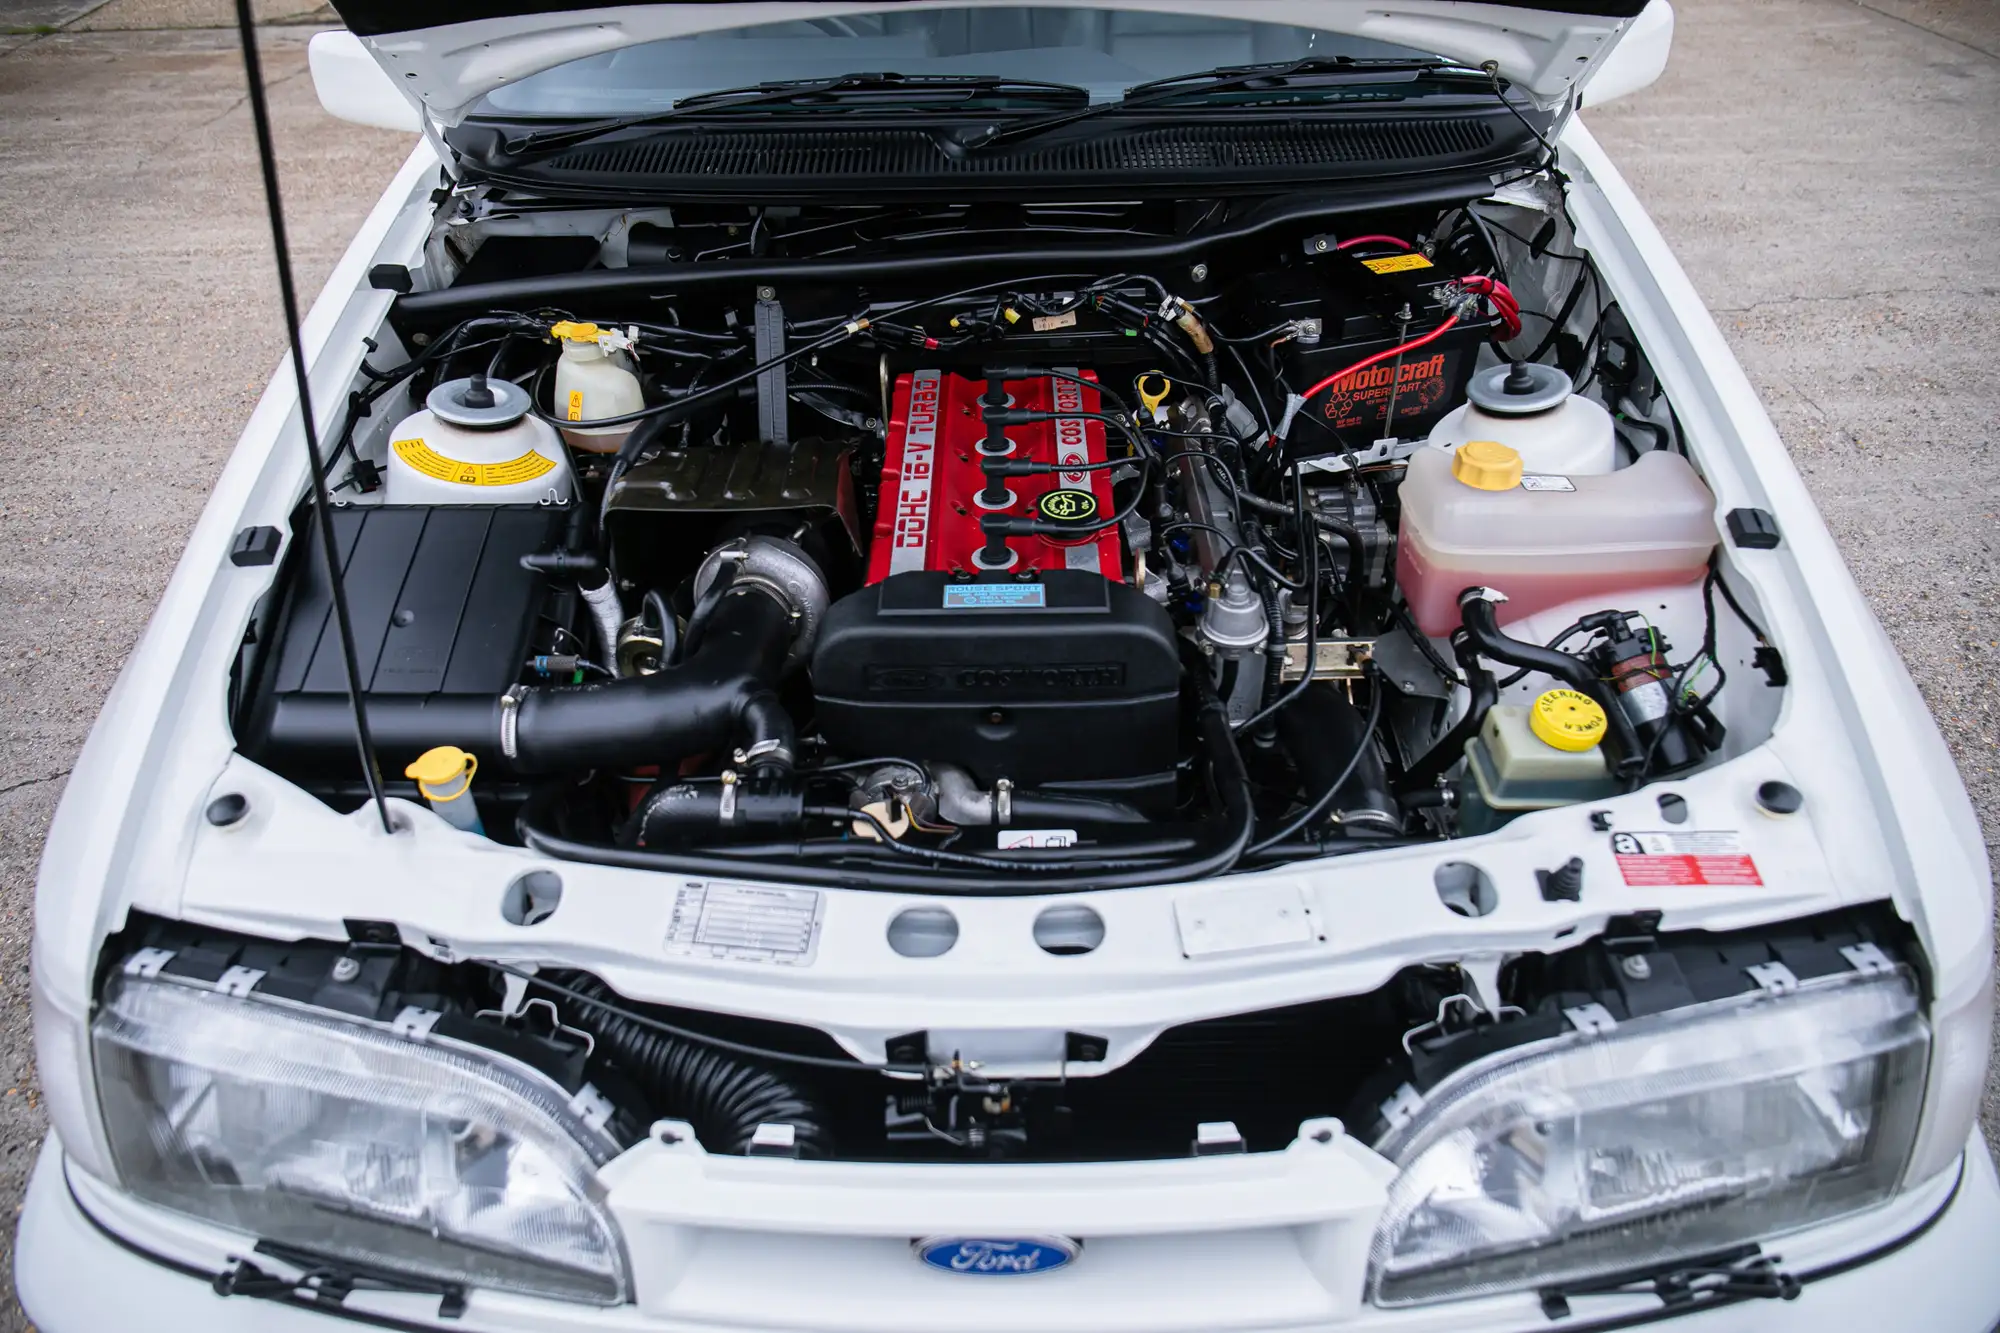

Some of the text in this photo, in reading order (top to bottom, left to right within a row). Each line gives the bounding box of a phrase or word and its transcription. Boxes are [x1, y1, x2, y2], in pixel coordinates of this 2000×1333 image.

[1333, 354, 1445, 393] Motorcraft
[1056, 376, 1082, 446] COSORTH
[896, 378, 938, 548] DOHC 16-V TURBO
[1541, 690, 1593, 712] STEERING
[1564, 715, 1604, 732] POWER
[951, 1240, 1042, 1271] Ford
